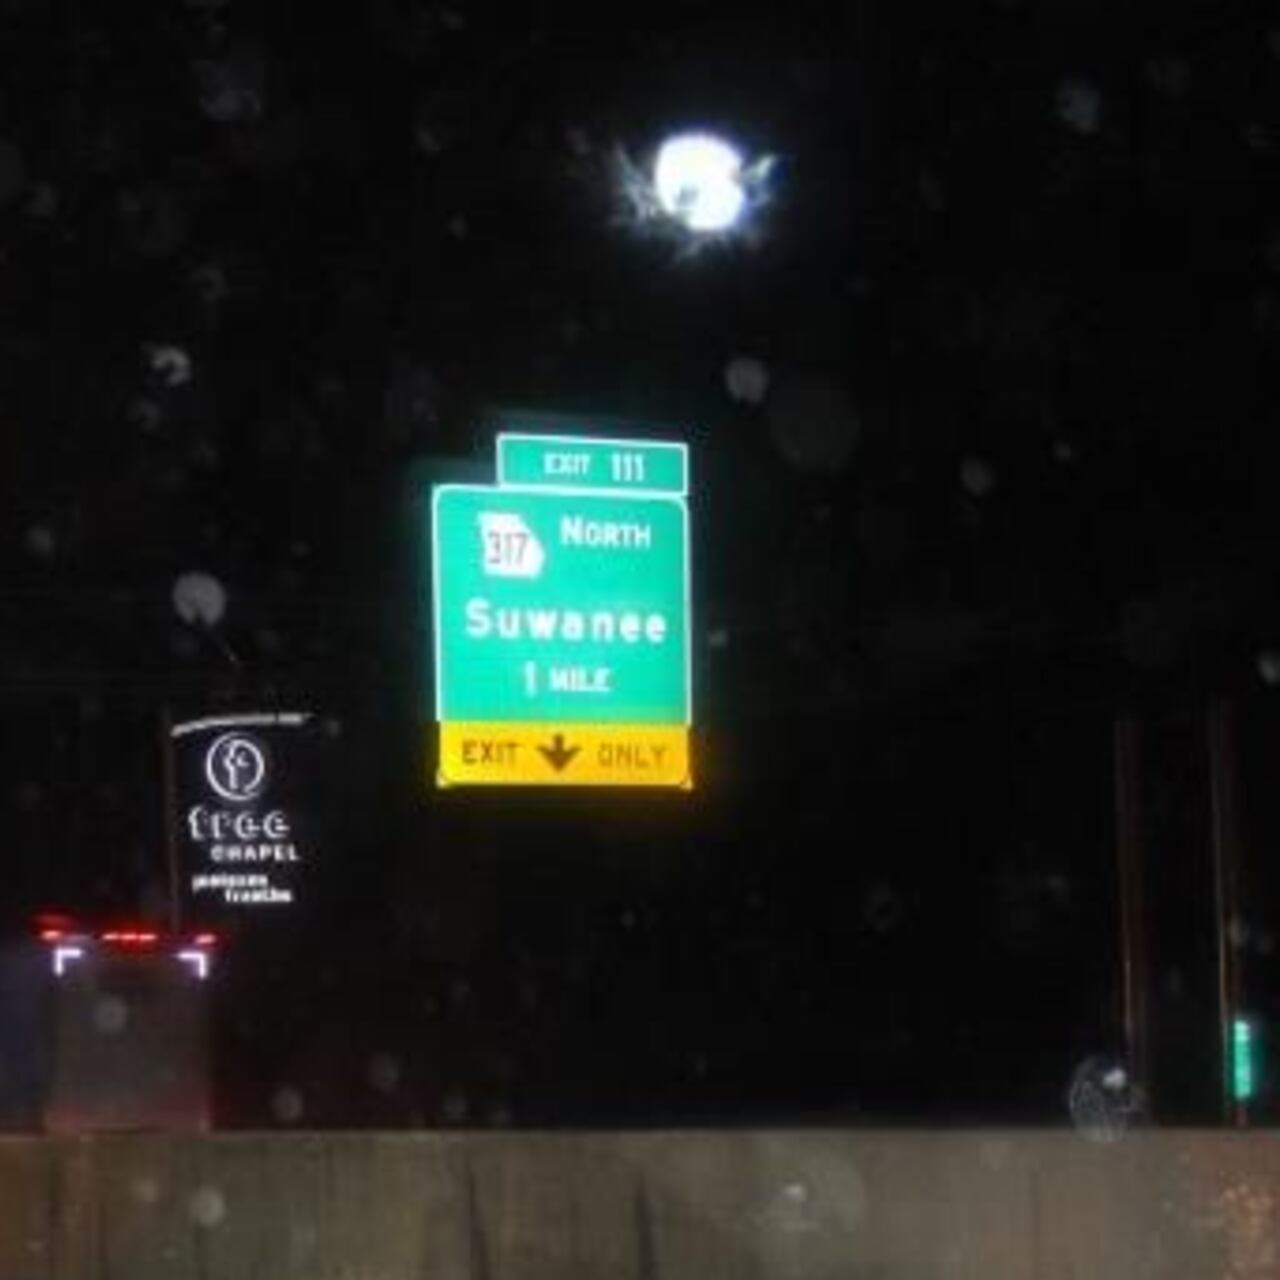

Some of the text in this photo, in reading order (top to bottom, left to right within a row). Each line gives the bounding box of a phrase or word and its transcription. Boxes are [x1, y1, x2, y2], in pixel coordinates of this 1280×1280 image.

[543, 451, 645, 481] EXIT 111
[486, 530, 530, 565] 317
[464, 598, 668, 642] Suwanee
[523, 660, 613, 694] 1 MILE
[460, 739, 668, 768] EXIT ONLY
[209, 844, 300, 862] CHAPEL
